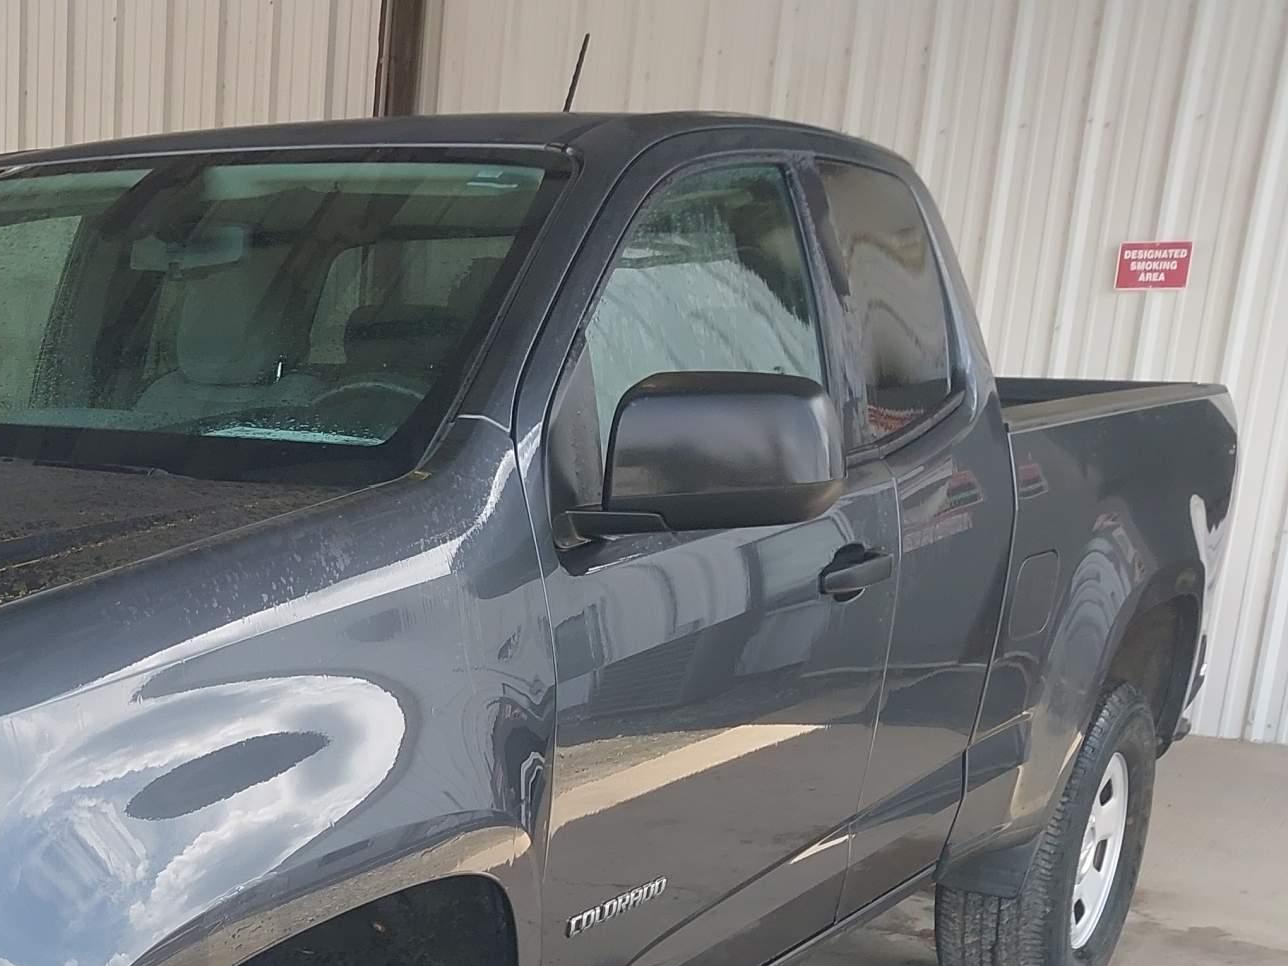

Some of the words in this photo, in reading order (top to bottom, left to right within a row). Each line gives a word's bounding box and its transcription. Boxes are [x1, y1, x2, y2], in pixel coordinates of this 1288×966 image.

[1124, 249, 1187, 259] DESIGNATED
[1130, 260, 1178, 271] SMOKING
[1138, 272, 1165, 282] AREA
[568, 876, 668, 937] COLORADO
